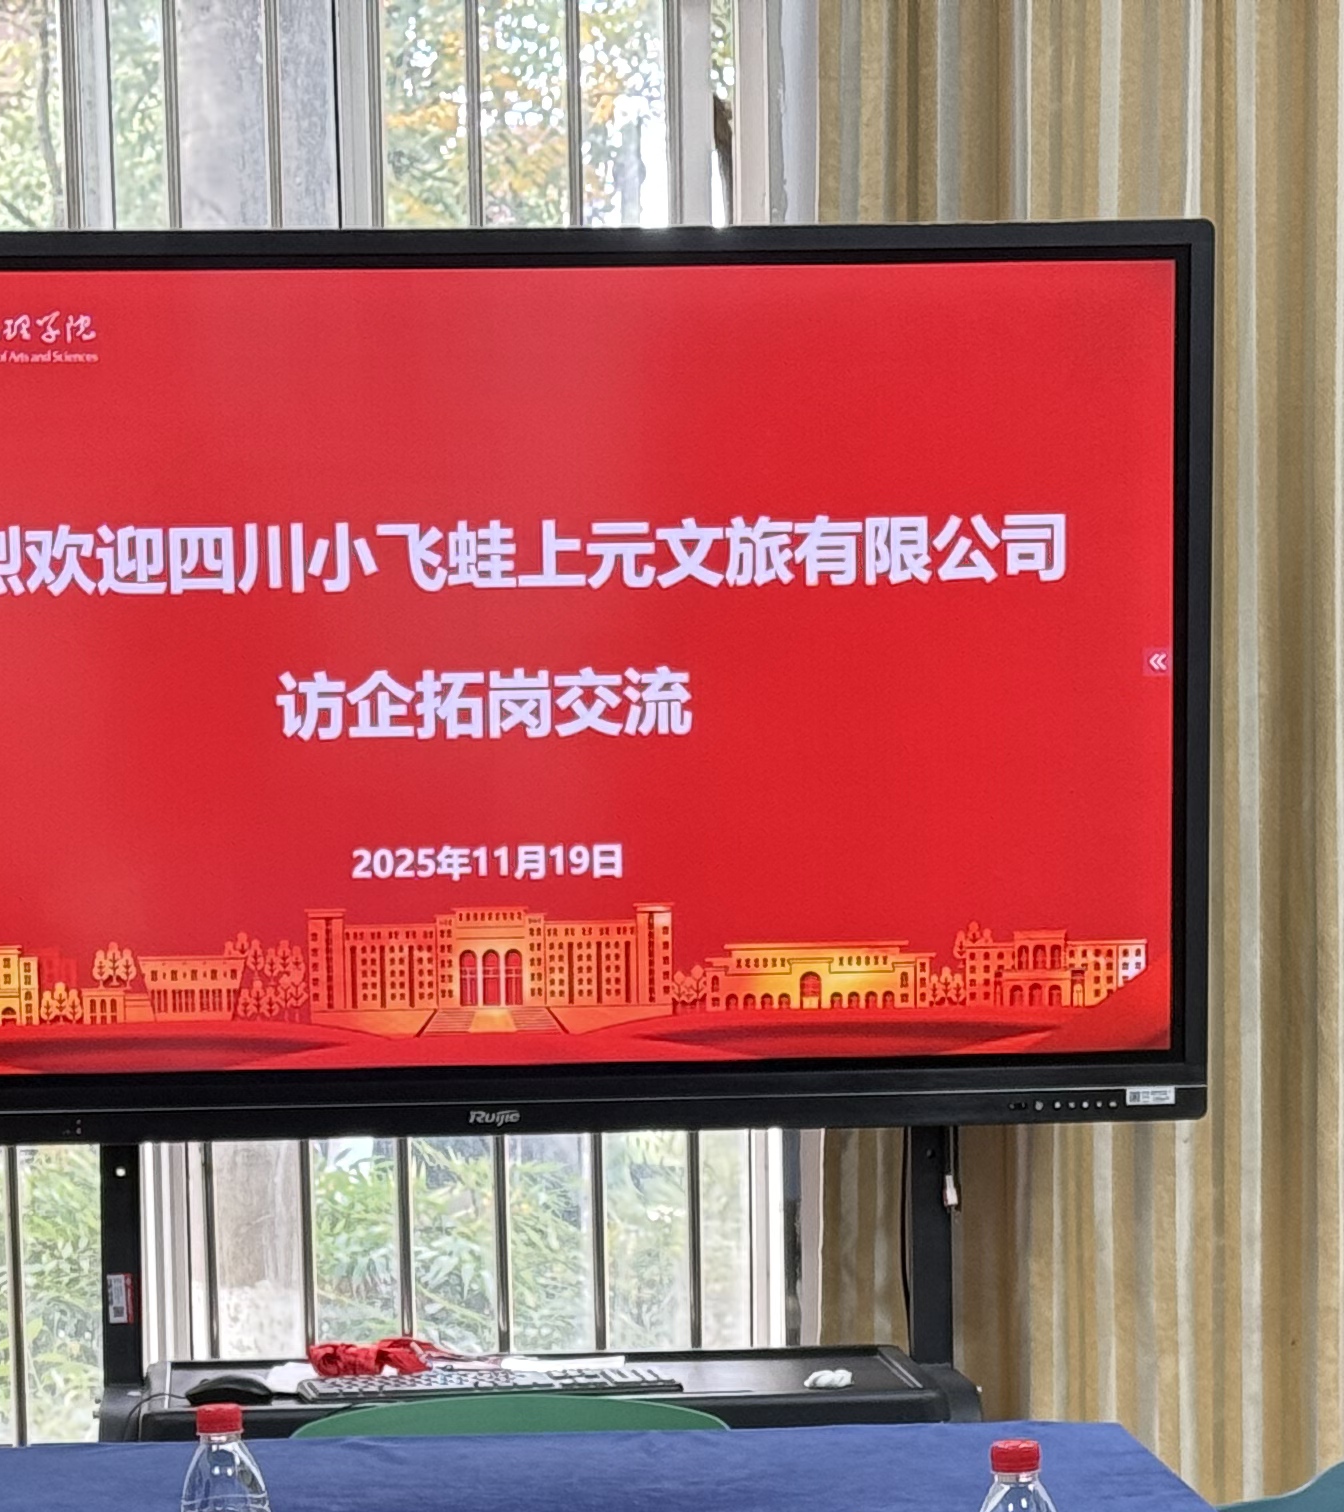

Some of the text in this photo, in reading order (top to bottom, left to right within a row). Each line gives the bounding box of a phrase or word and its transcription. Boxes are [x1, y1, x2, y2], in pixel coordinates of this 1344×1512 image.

[53, 351, 99, 363] Sciences
[275, 666, 693, 743] 访企拓岗交流
[352, 843, 623, 881] 2025年11月19日
